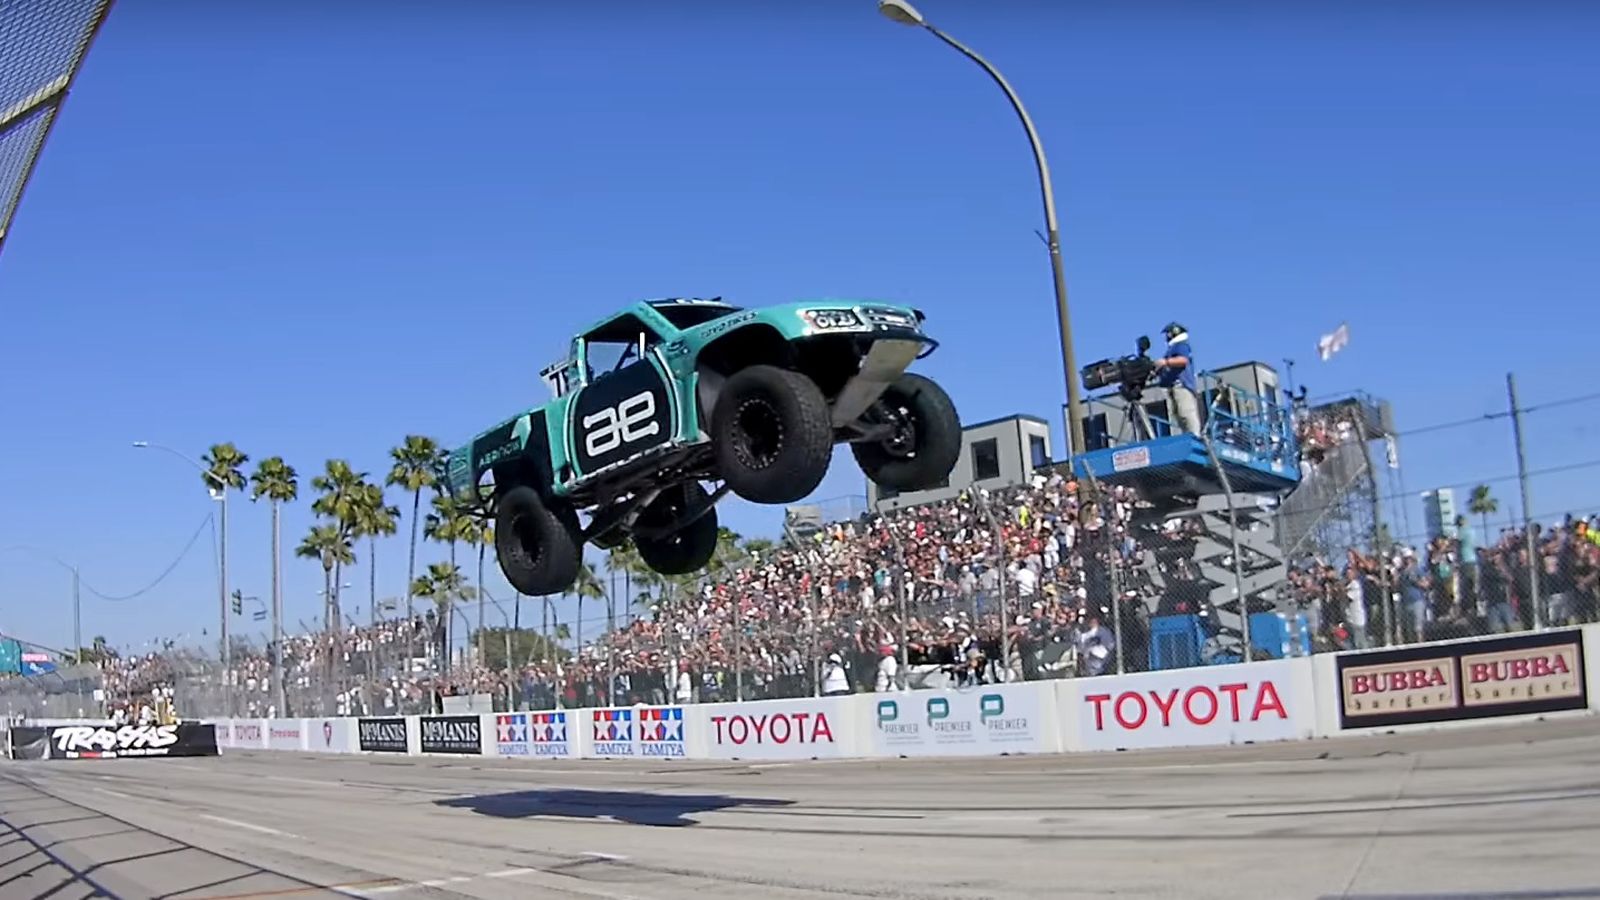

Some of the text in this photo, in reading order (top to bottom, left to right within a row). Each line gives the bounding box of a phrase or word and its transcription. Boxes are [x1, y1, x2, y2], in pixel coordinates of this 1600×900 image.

[1469, 654, 1570, 684] BUBBA
[1350, 666, 1447, 695] BUBBA
[1474, 680, 1569, 700] burger
[1084, 680, 1288, 731] TOYOTA
[1353, 691, 1446, 710] burger
[711, 712, 834, 745] TOYOTA
[884, 723, 919, 734] PREMIER
[934, 721, 971, 733] PREMIER
[988, 718, 1027, 730] PREMIER
[53, 725, 178, 751] TRAXXAS
[498, 744, 529, 756] TAMIYA
[533, 743, 568, 756] TAMIYA
[594, 743, 634, 756] TAMIYA
[641, 743, 685, 757] TAMIYA
